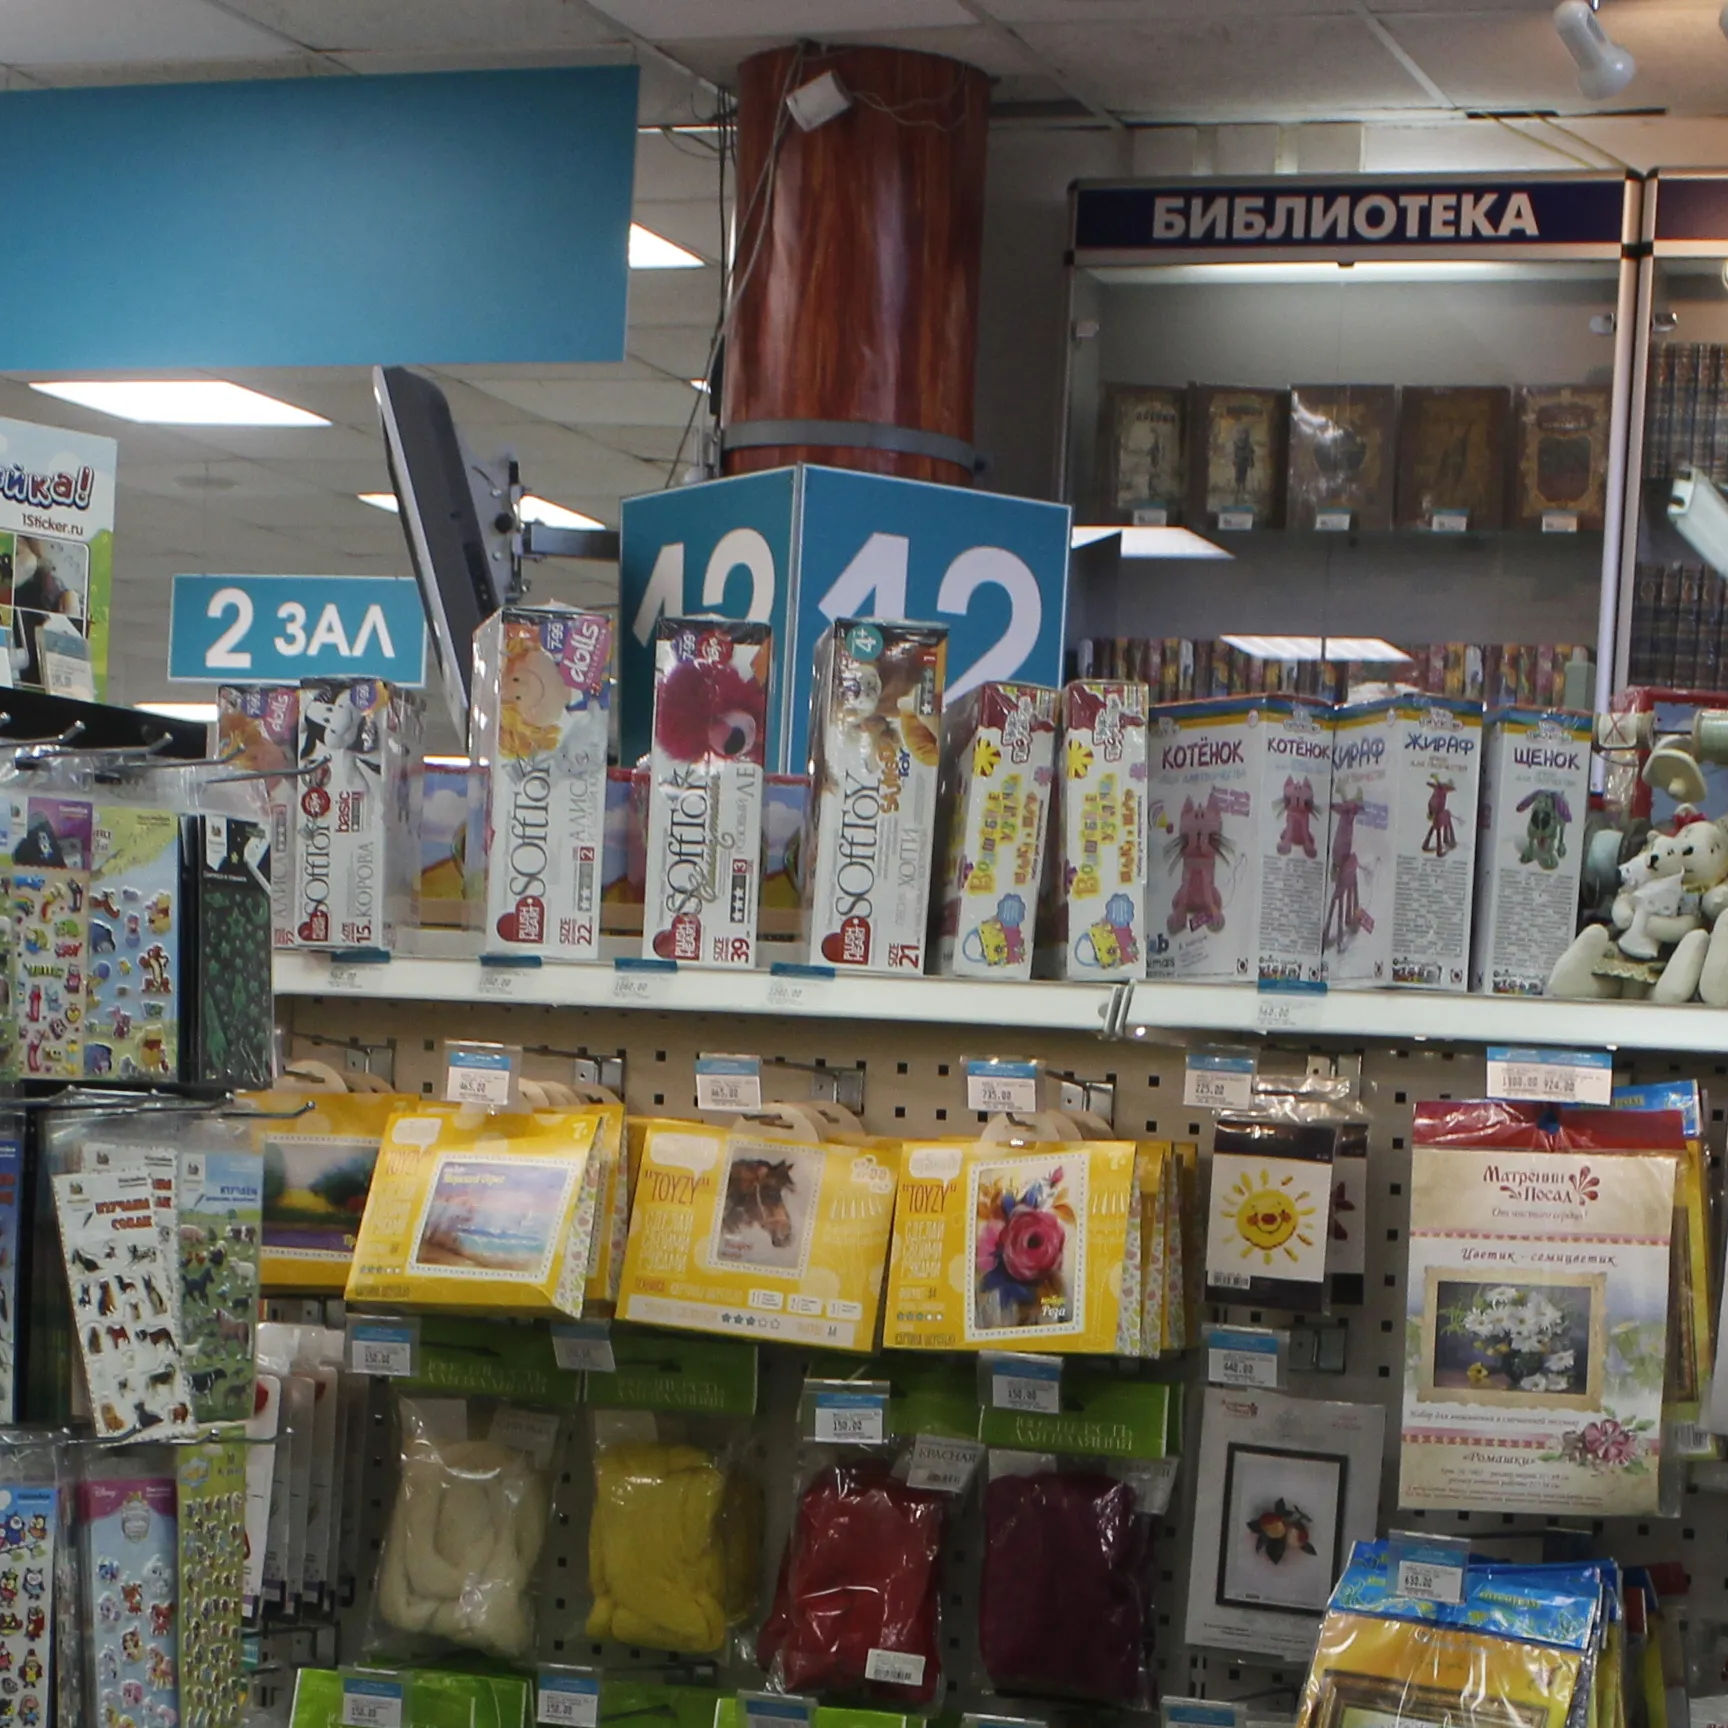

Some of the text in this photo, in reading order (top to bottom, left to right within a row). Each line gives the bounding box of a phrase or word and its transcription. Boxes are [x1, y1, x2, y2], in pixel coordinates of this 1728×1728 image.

[1151, 192, 1540, 241] БИБЛИОТЕКА
[204, 587, 396, 670] 2 ЗАЛ
[1161, 739, 1245, 770] КОТЁНОК
[1267, 738, 1331, 760] КОТЁНОК
[1404, 732, 1475, 756] ЖИРАФ
[1513, 747, 1581, 771] ЩЕНОК
[354, 842, 375, 919] КОРОВА
[577, 922, 593, 947] 22
[730, 937, 750, 965] 39
[900, 943, 920, 968] 21
